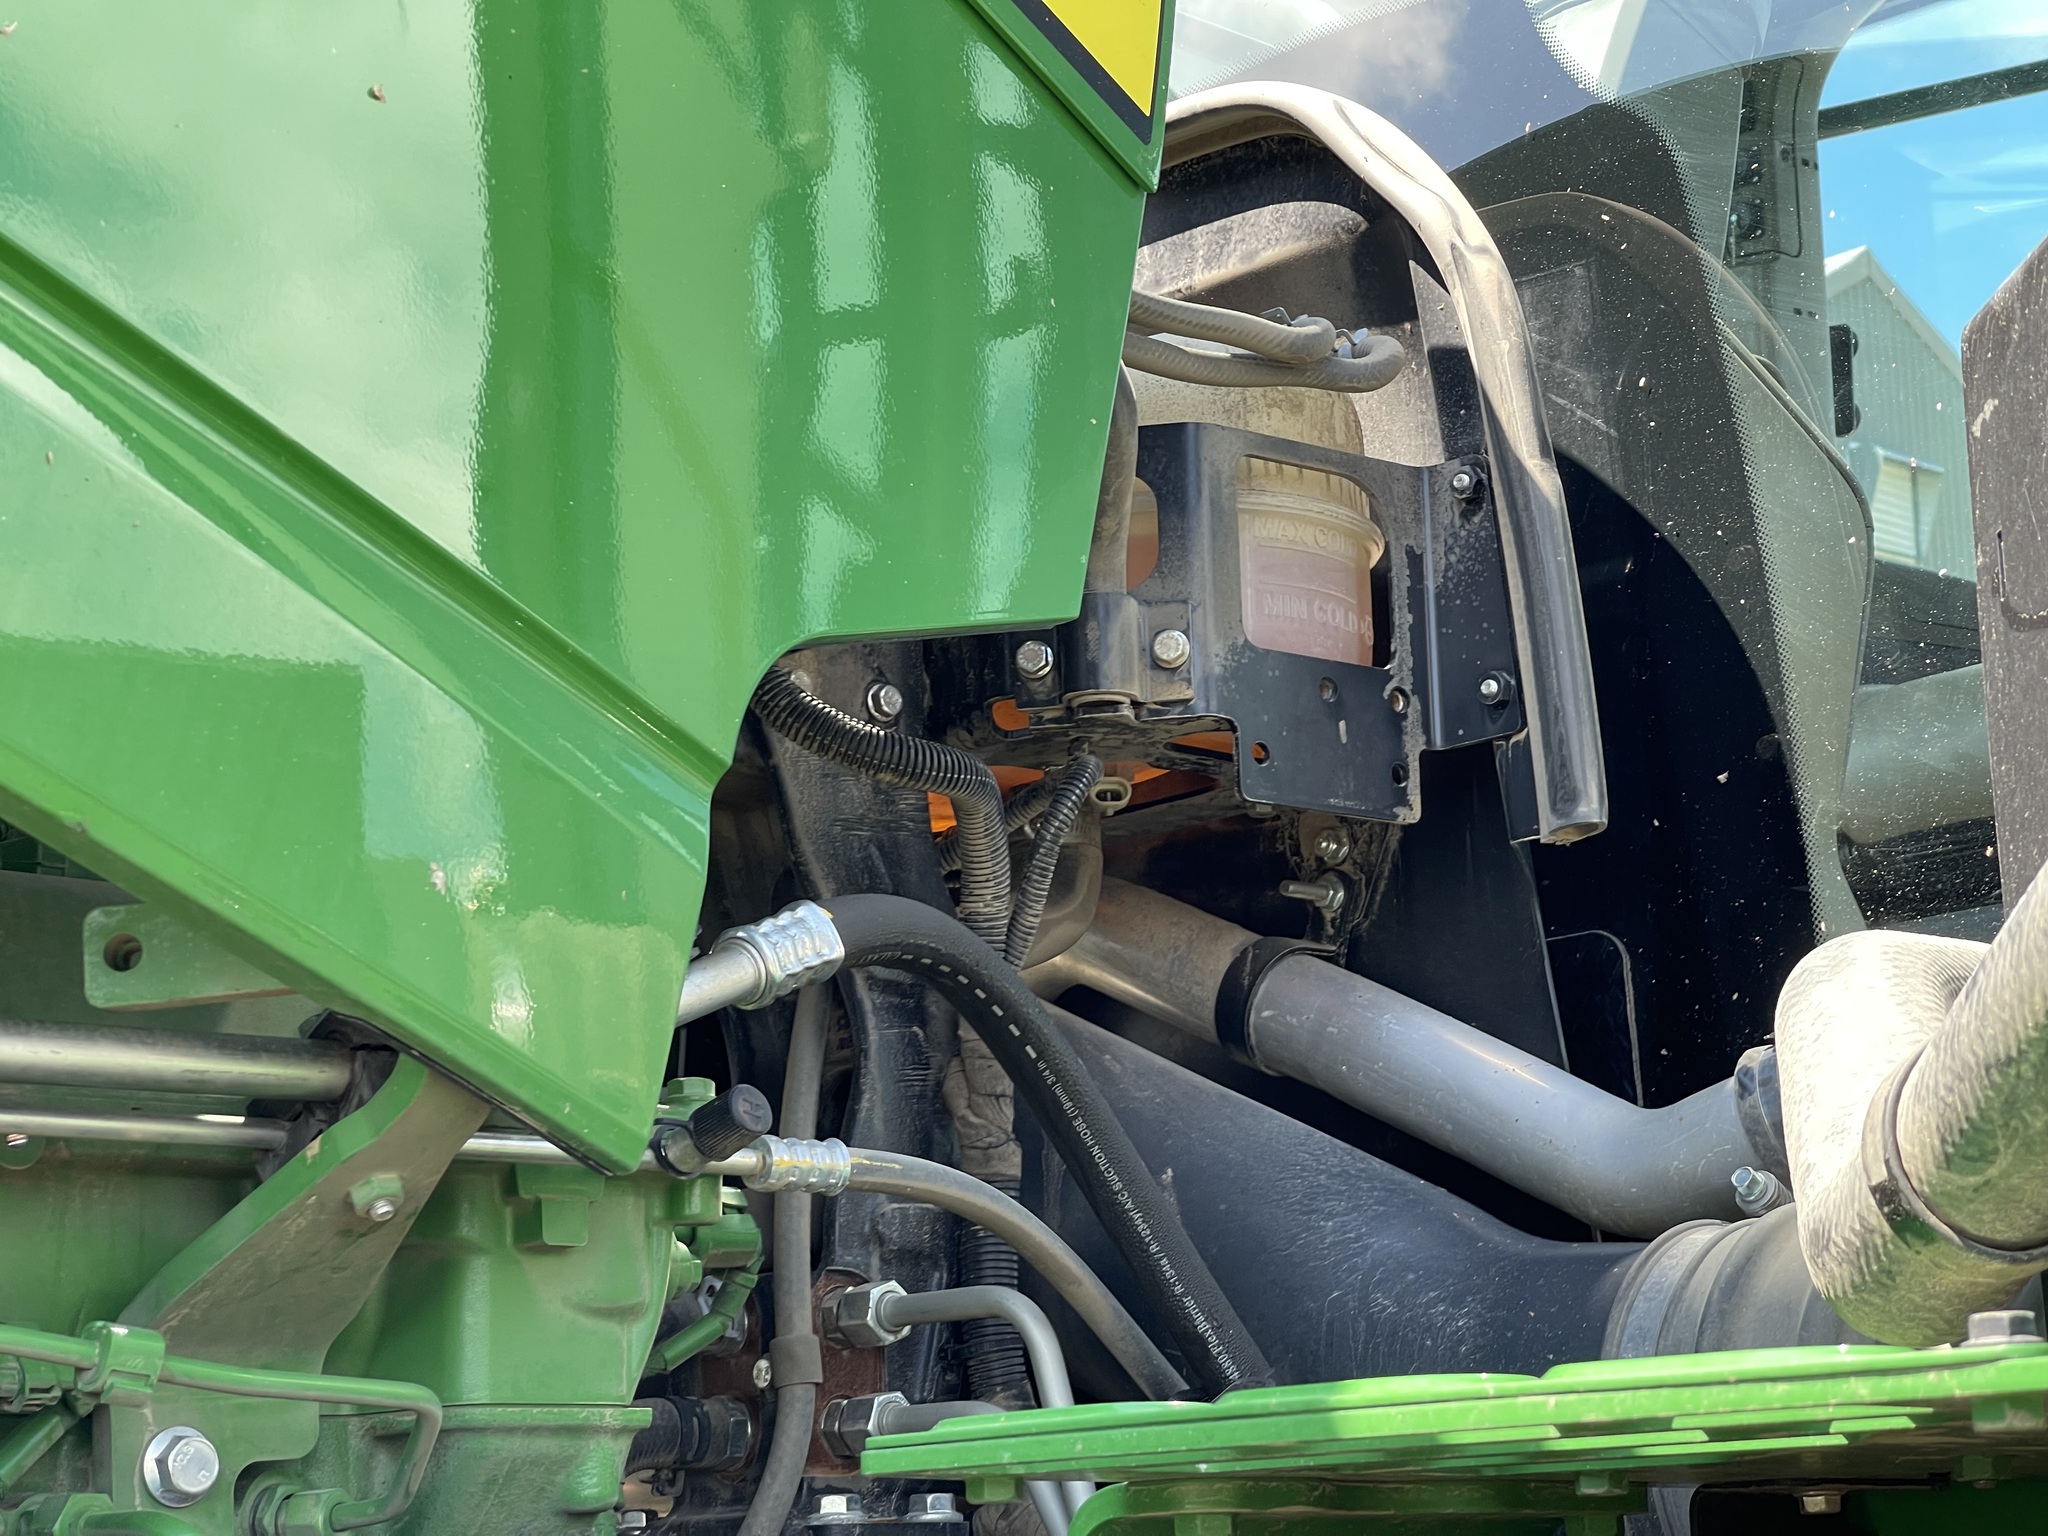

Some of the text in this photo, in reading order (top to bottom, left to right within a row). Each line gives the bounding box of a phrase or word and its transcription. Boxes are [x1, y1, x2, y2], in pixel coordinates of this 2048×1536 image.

[1253, 515, 1308, 546] MAX
[1264, 593, 1307, 619] MIN
[1313, 602, 1358, 634] COLD
[1042, 1069, 1057, 1085] 3/4
[1051, 1082, 1079, 1117] (19mm)
[1072, 1116, 1096, 1147] HOSE
[1089, 1145, 1123, 1191] SUCTION
[1217, 1353, 1241, 1380] 4880
